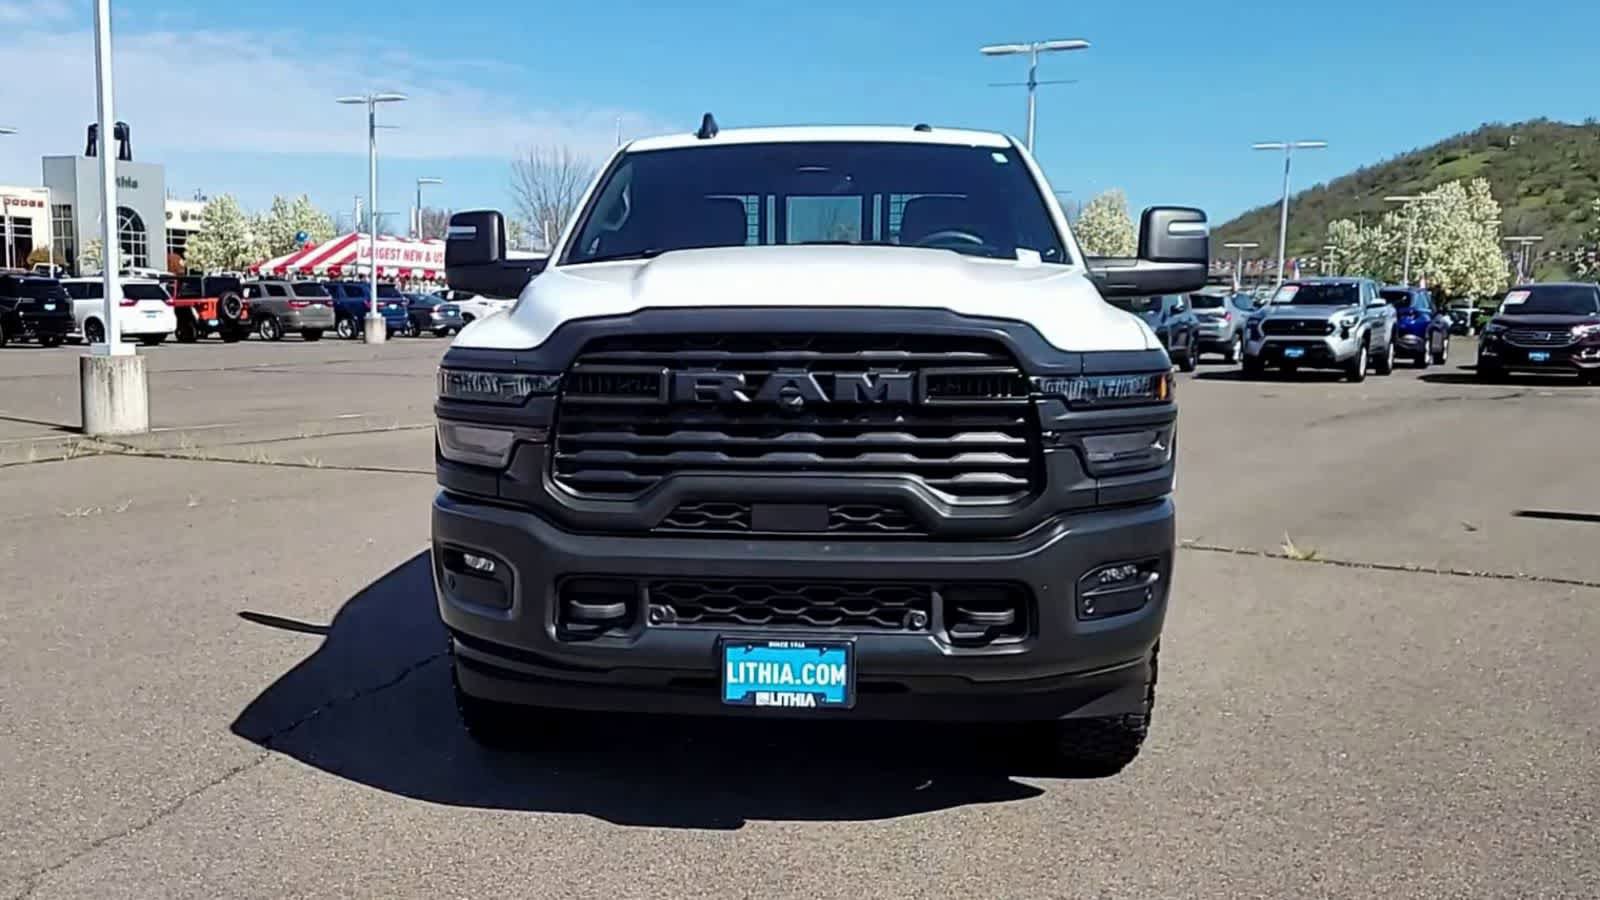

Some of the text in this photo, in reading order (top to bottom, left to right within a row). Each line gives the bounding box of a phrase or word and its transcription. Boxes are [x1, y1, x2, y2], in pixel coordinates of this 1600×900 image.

[403, 248, 424, 263] NEW
[425, 251, 431, 263] &
[674, 371, 914, 403] RAM
[726, 661, 847, 686] LITHIA.COM
[769, 691, 816, 708] LITHIA
